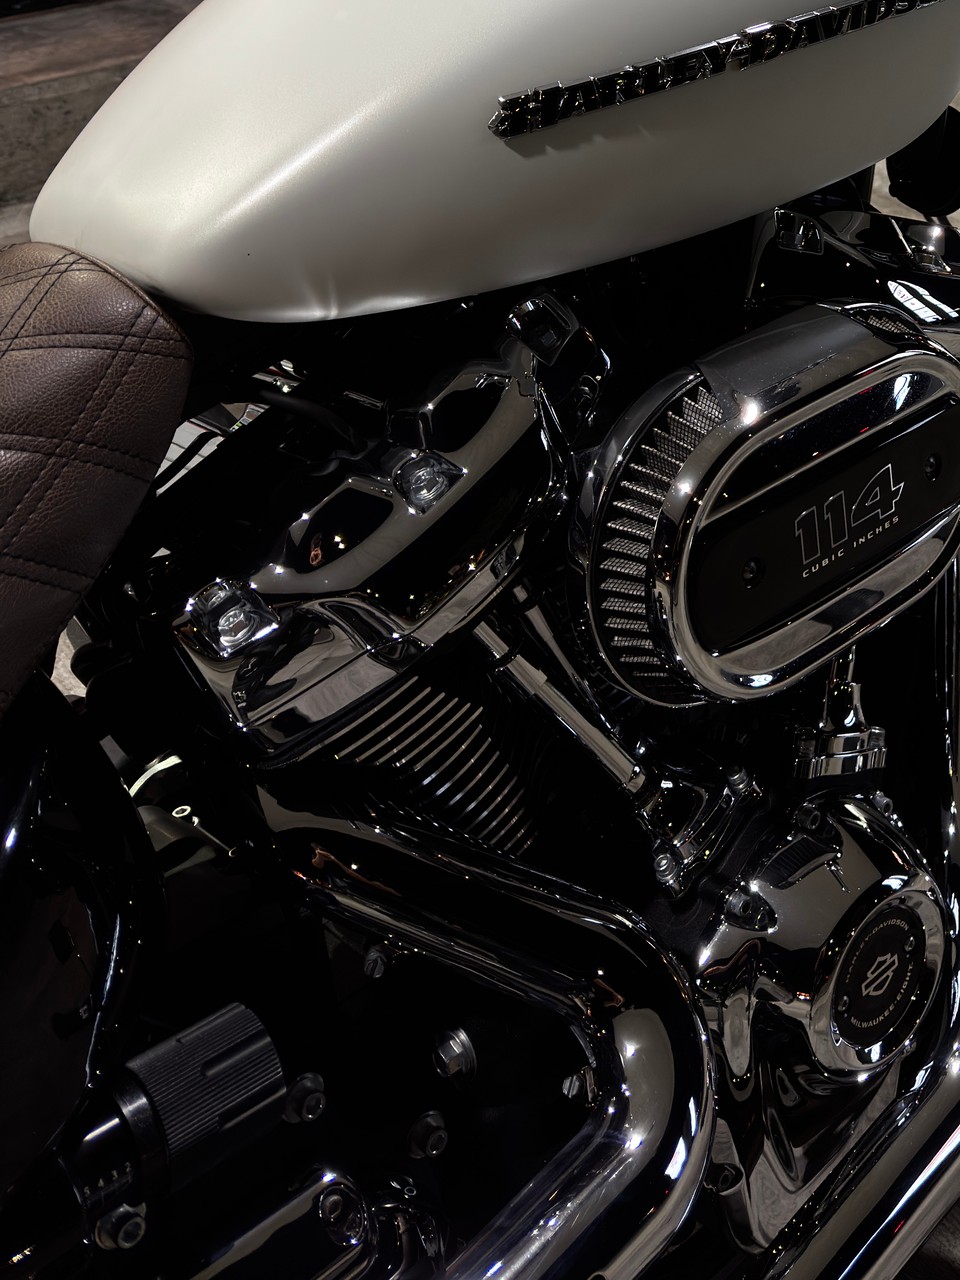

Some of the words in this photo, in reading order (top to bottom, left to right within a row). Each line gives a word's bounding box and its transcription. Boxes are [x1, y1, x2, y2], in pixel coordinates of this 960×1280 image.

[795, 463, 905, 565] 114
[802, 548, 845, 578] CUBIC
[853, 516, 899, 548] INCHES
